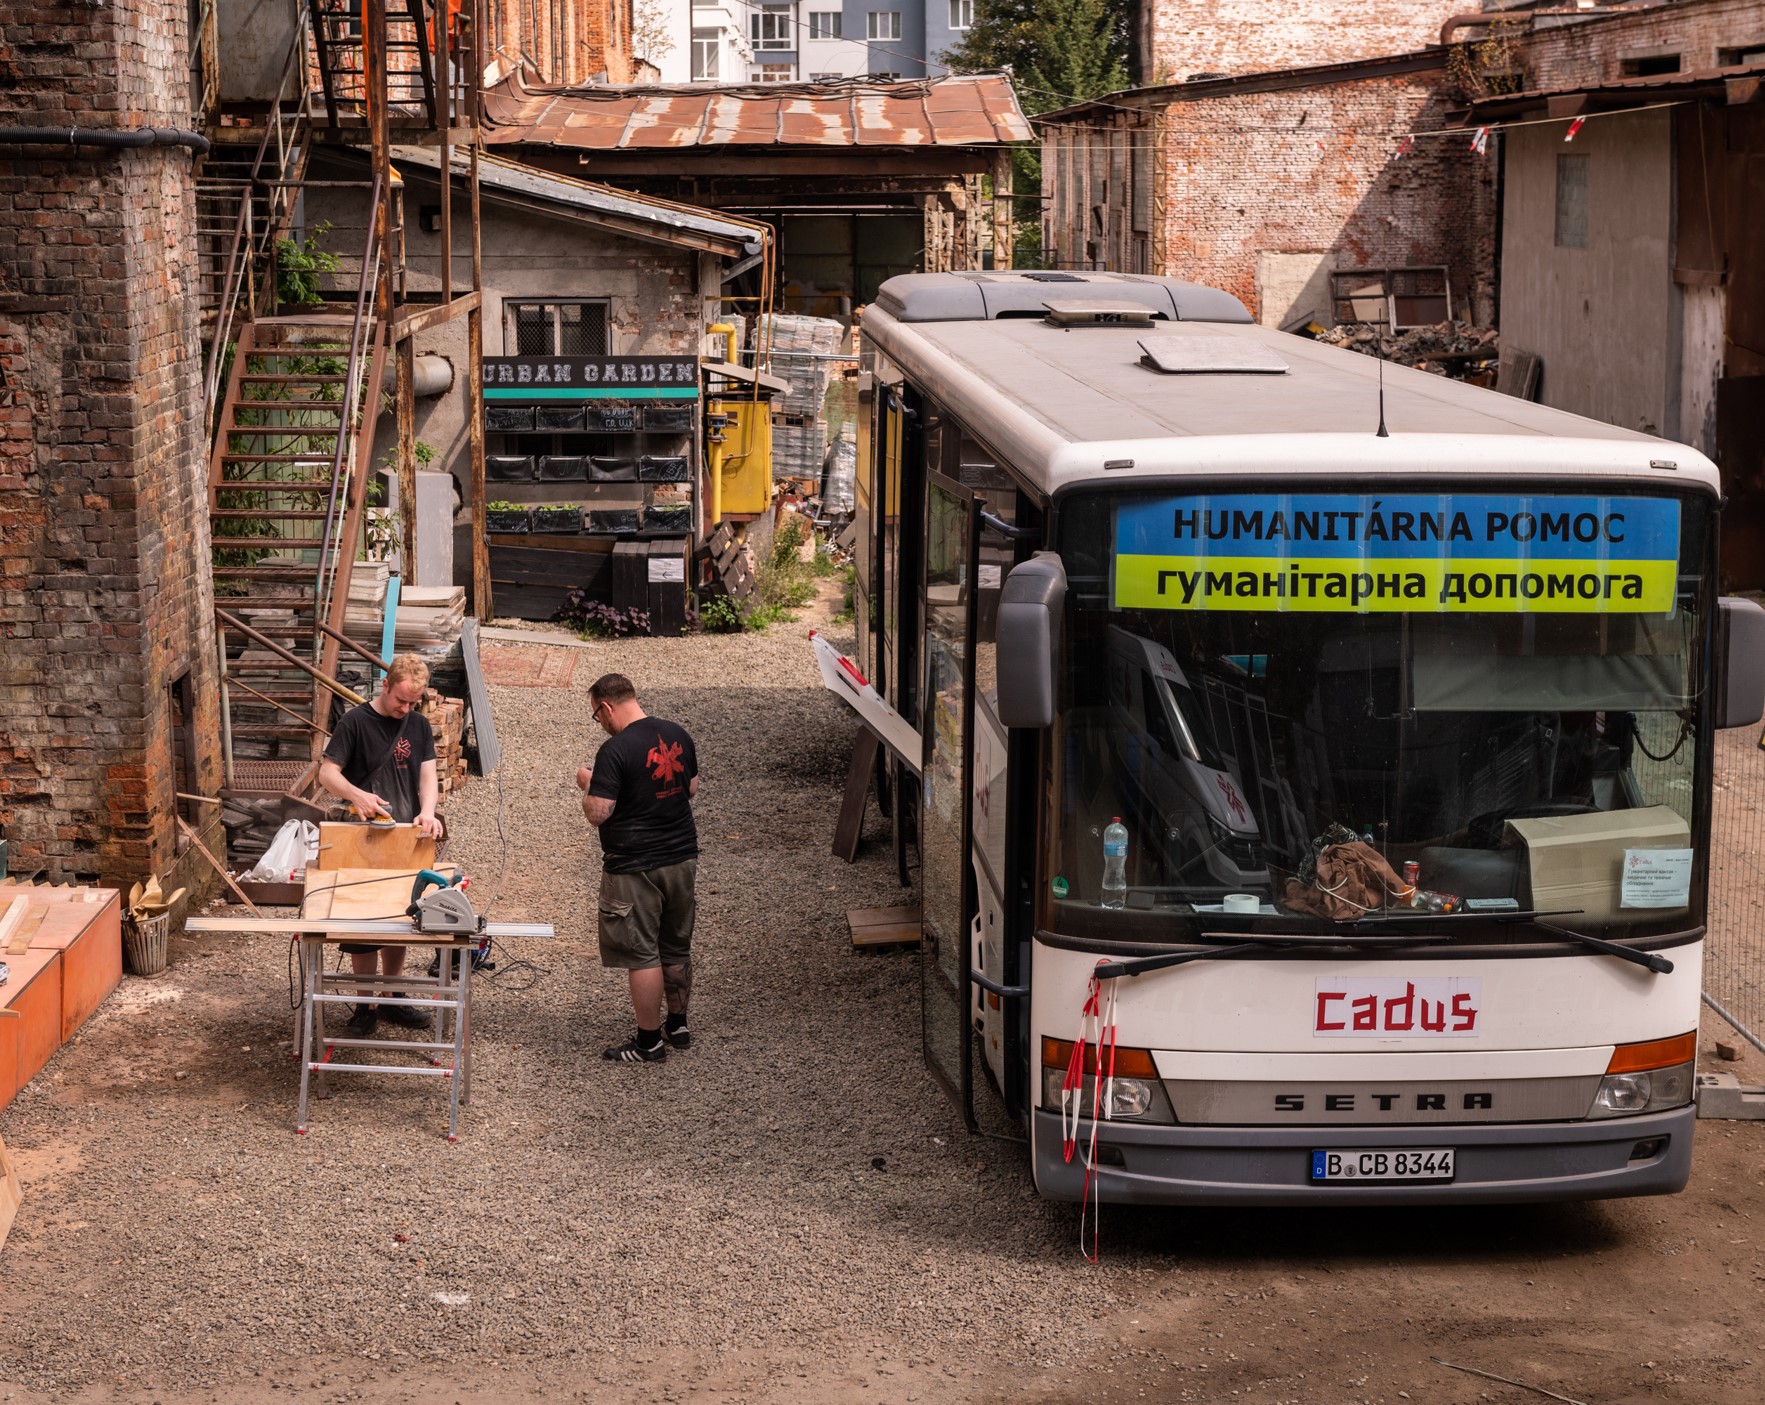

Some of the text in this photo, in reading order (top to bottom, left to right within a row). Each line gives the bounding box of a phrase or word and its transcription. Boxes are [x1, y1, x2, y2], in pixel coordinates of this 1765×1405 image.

[483, 363, 694, 382] URBAN GARDEN
[1173, 502, 1625, 543] HUMANITÁRNA POMOC
[1157, 564, 1643, 606] гуманітарна допомога
[1316, 981, 1478, 1032] Cadus
[1275, 1093, 1492, 1111] SETRA
[1328, 1154, 1342, 1176] B
[1359, 1153, 1388, 1176] CB
[1395, 1153, 1451, 1175] 8344
